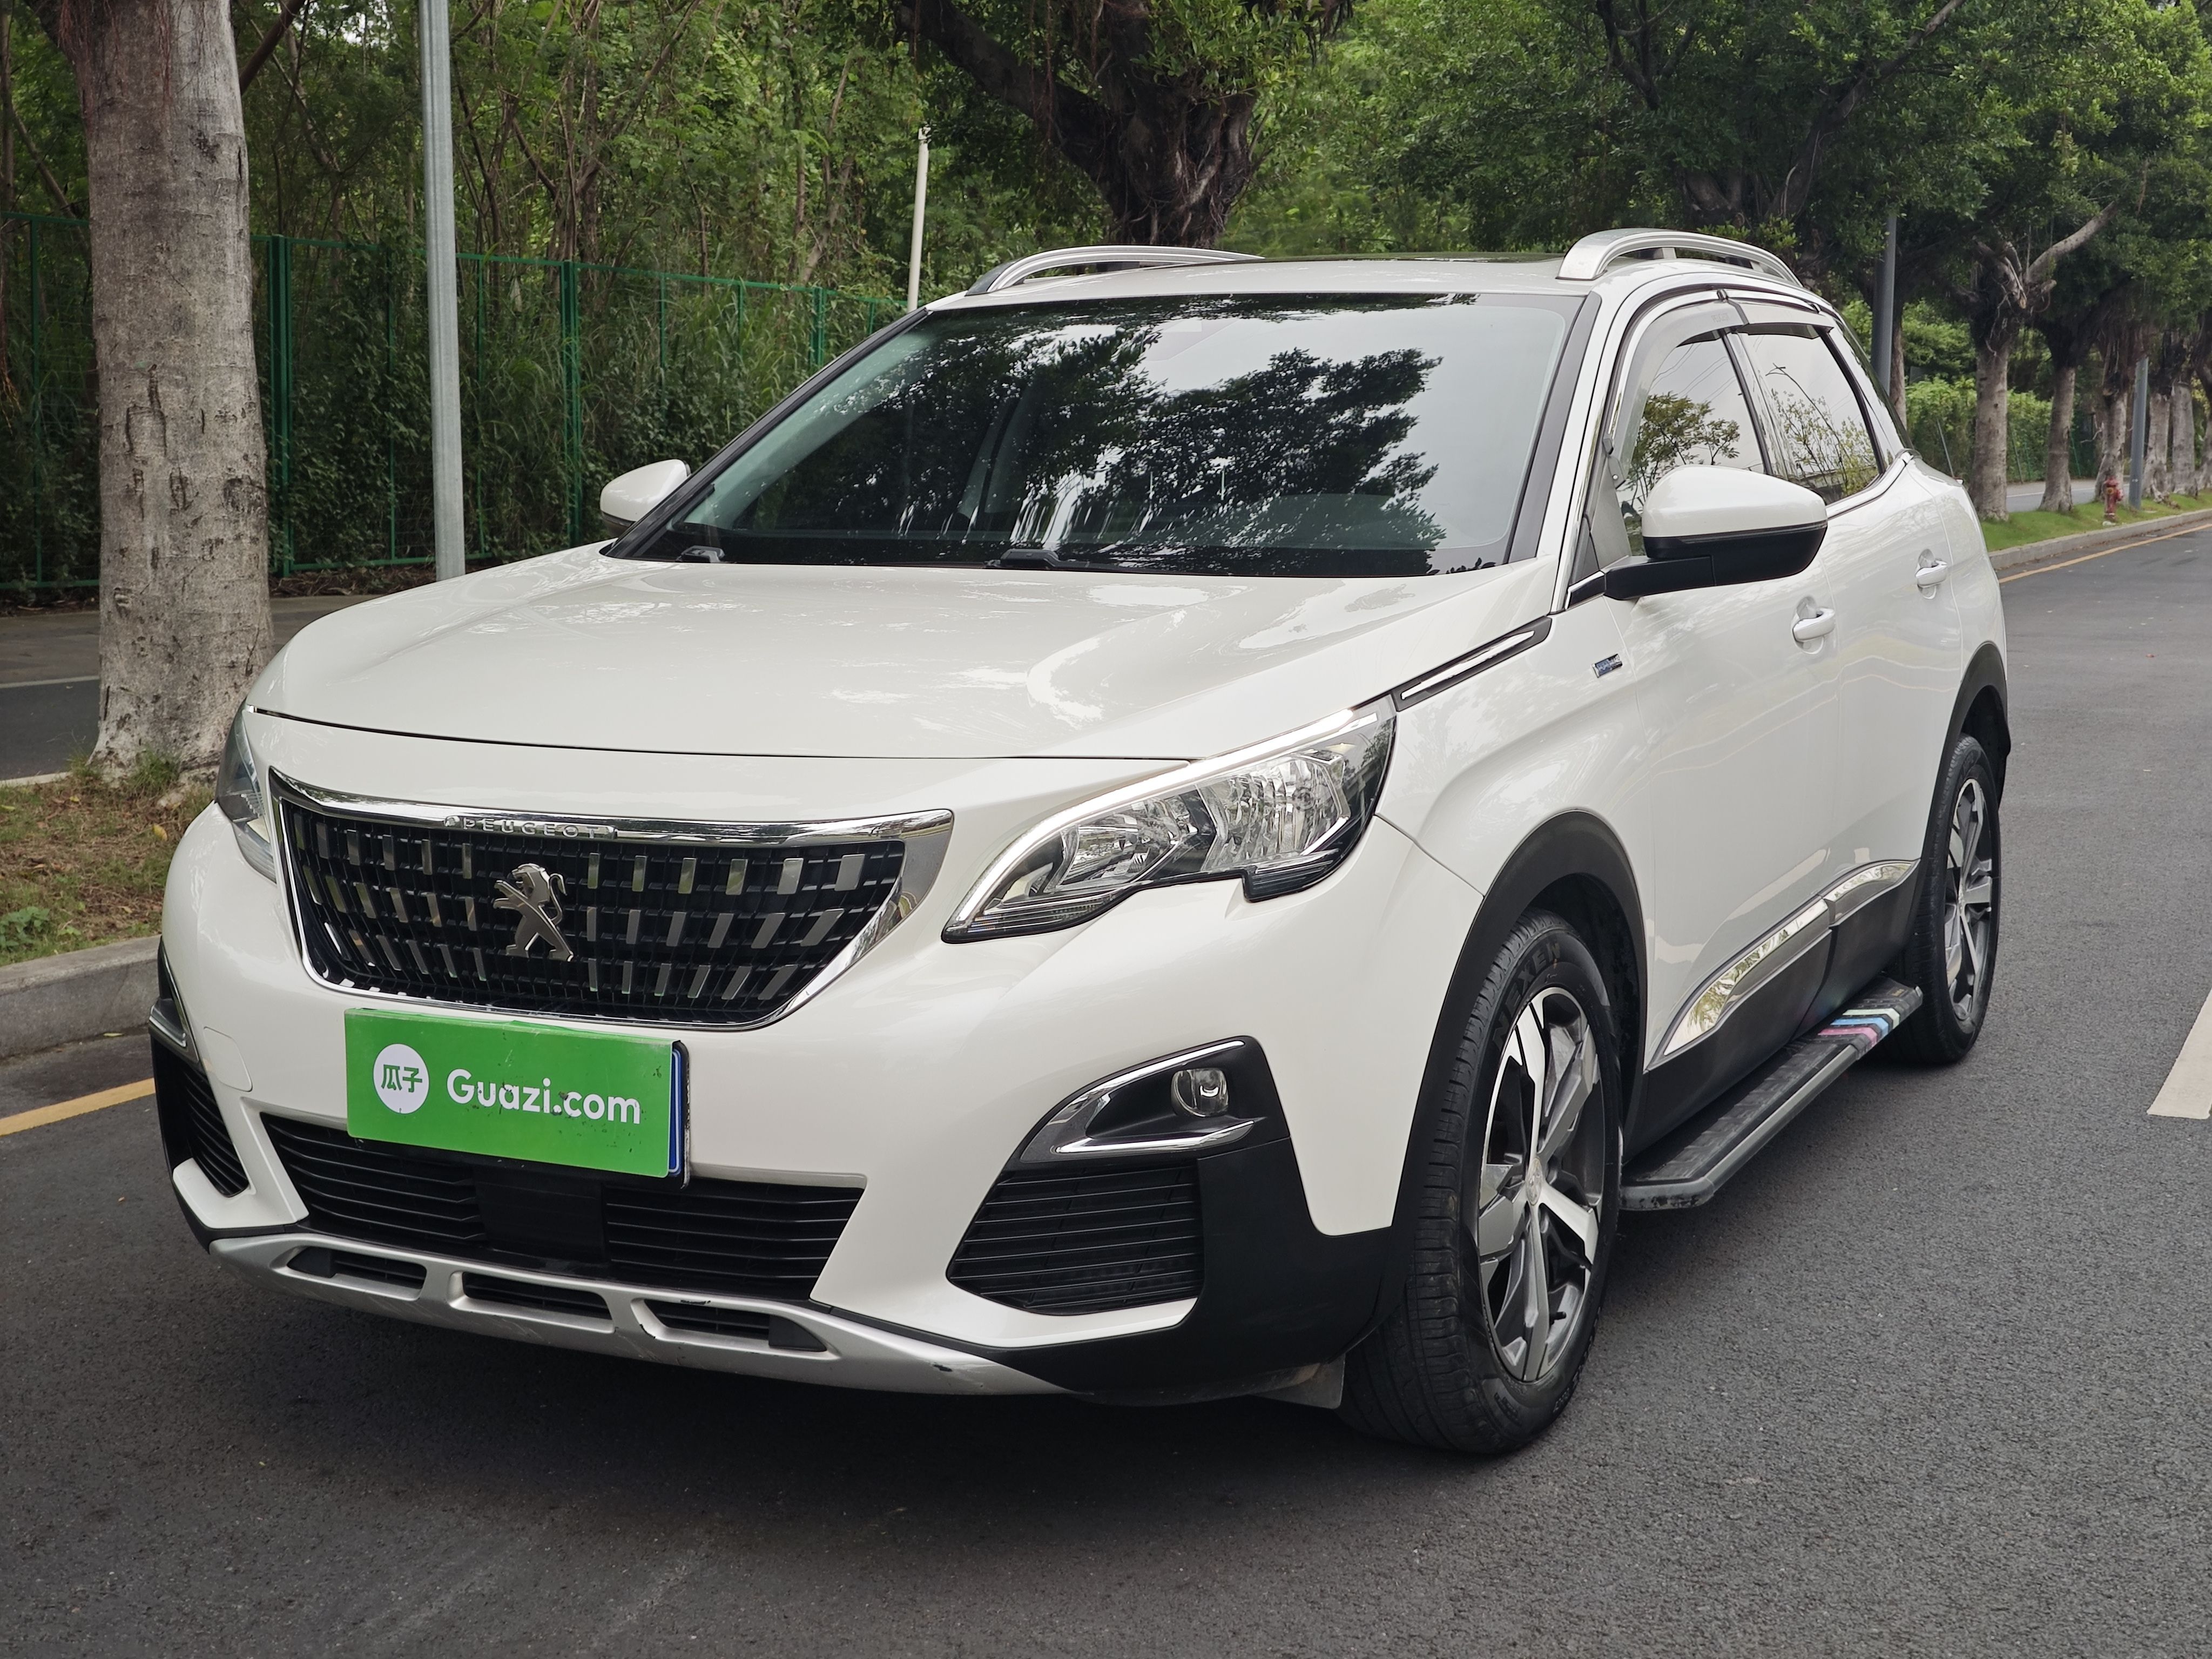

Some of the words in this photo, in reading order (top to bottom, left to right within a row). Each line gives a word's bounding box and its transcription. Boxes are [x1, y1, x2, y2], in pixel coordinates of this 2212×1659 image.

[463, 817, 598, 839] PEUGEOT
[1492, 942, 1560, 1051] NEXEN
[381, 1064, 422, 1092] 瓜子
[447, 1068, 640, 1124] Guazi.com
